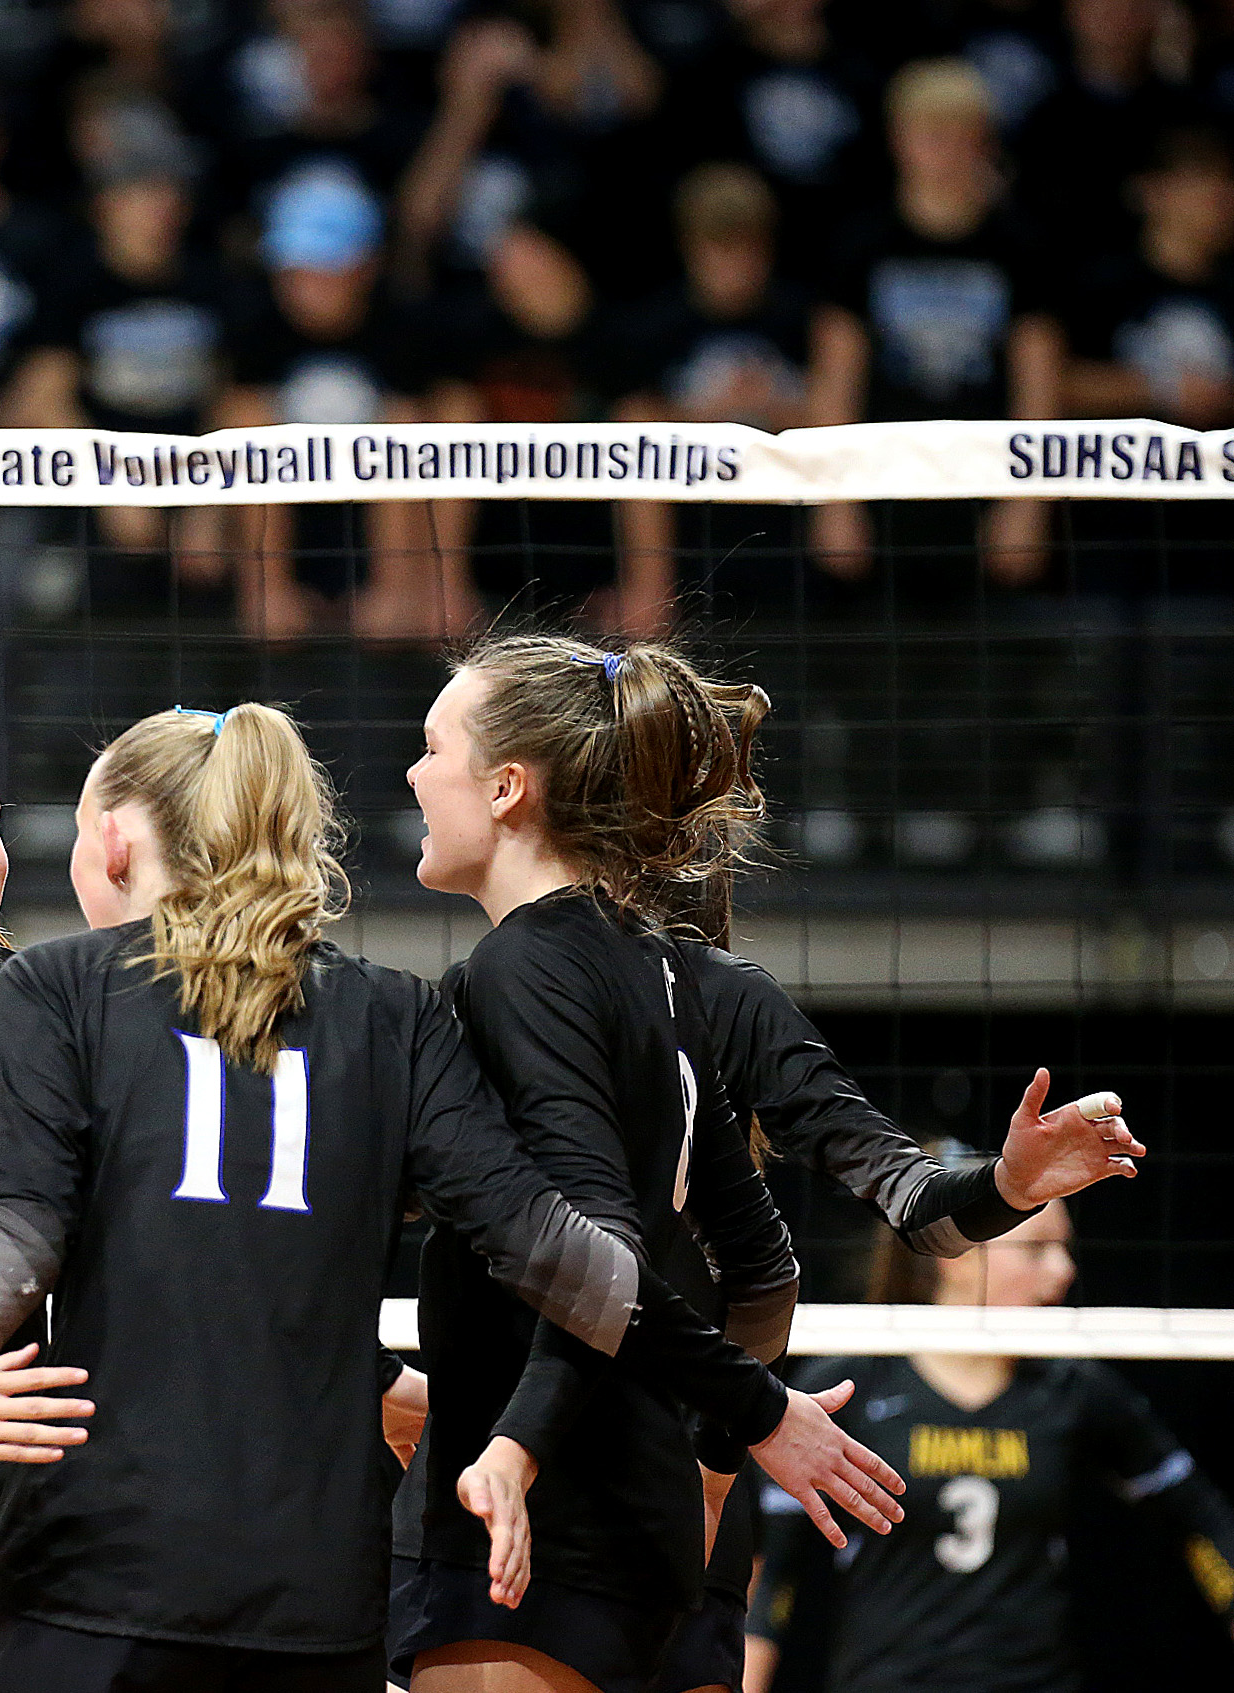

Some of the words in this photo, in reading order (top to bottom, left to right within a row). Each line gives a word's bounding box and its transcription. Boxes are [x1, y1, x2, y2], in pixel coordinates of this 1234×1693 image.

[93, 436, 332, 489] Volleyball
[353, 433, 740, 486] Championships
[1009, 433, 1203, 481] SDHSAA
[169, 1026, 313, 1215] 11
[933, 1475, 1000, 1574] 3
